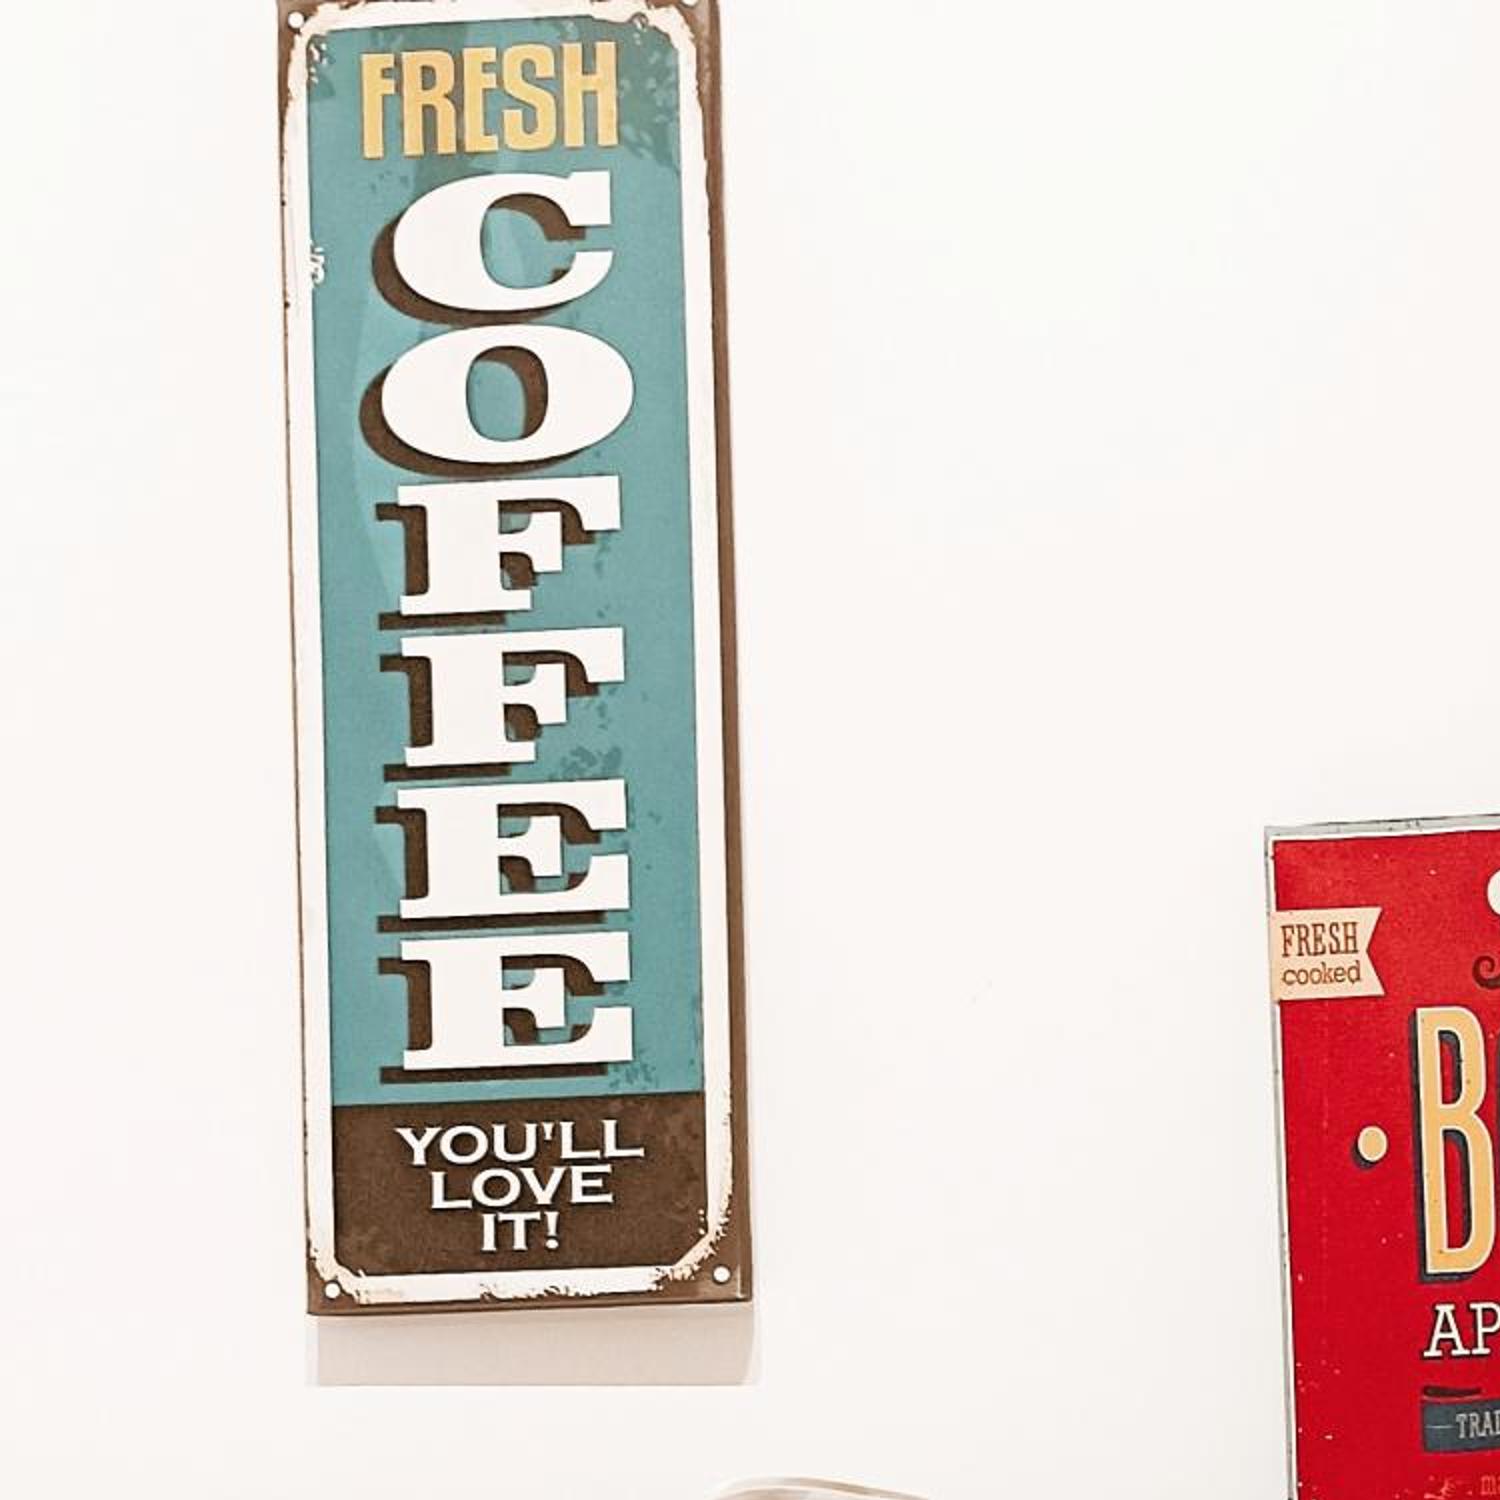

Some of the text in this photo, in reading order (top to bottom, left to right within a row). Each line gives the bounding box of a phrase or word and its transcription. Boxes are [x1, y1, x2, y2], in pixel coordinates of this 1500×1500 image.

[360, 41, 619, 159] FRESH
[372, 170, 634, 1072] COFFEE
[1280, 921, 1359, 958] FRESH
[1281, 959, 1362, 985] cooked
[396, 1120, 645, 1166] YOU'LL
[430, 1164, 613, 1210] LOVE
[481, 1210, 560, 1252] IT!
